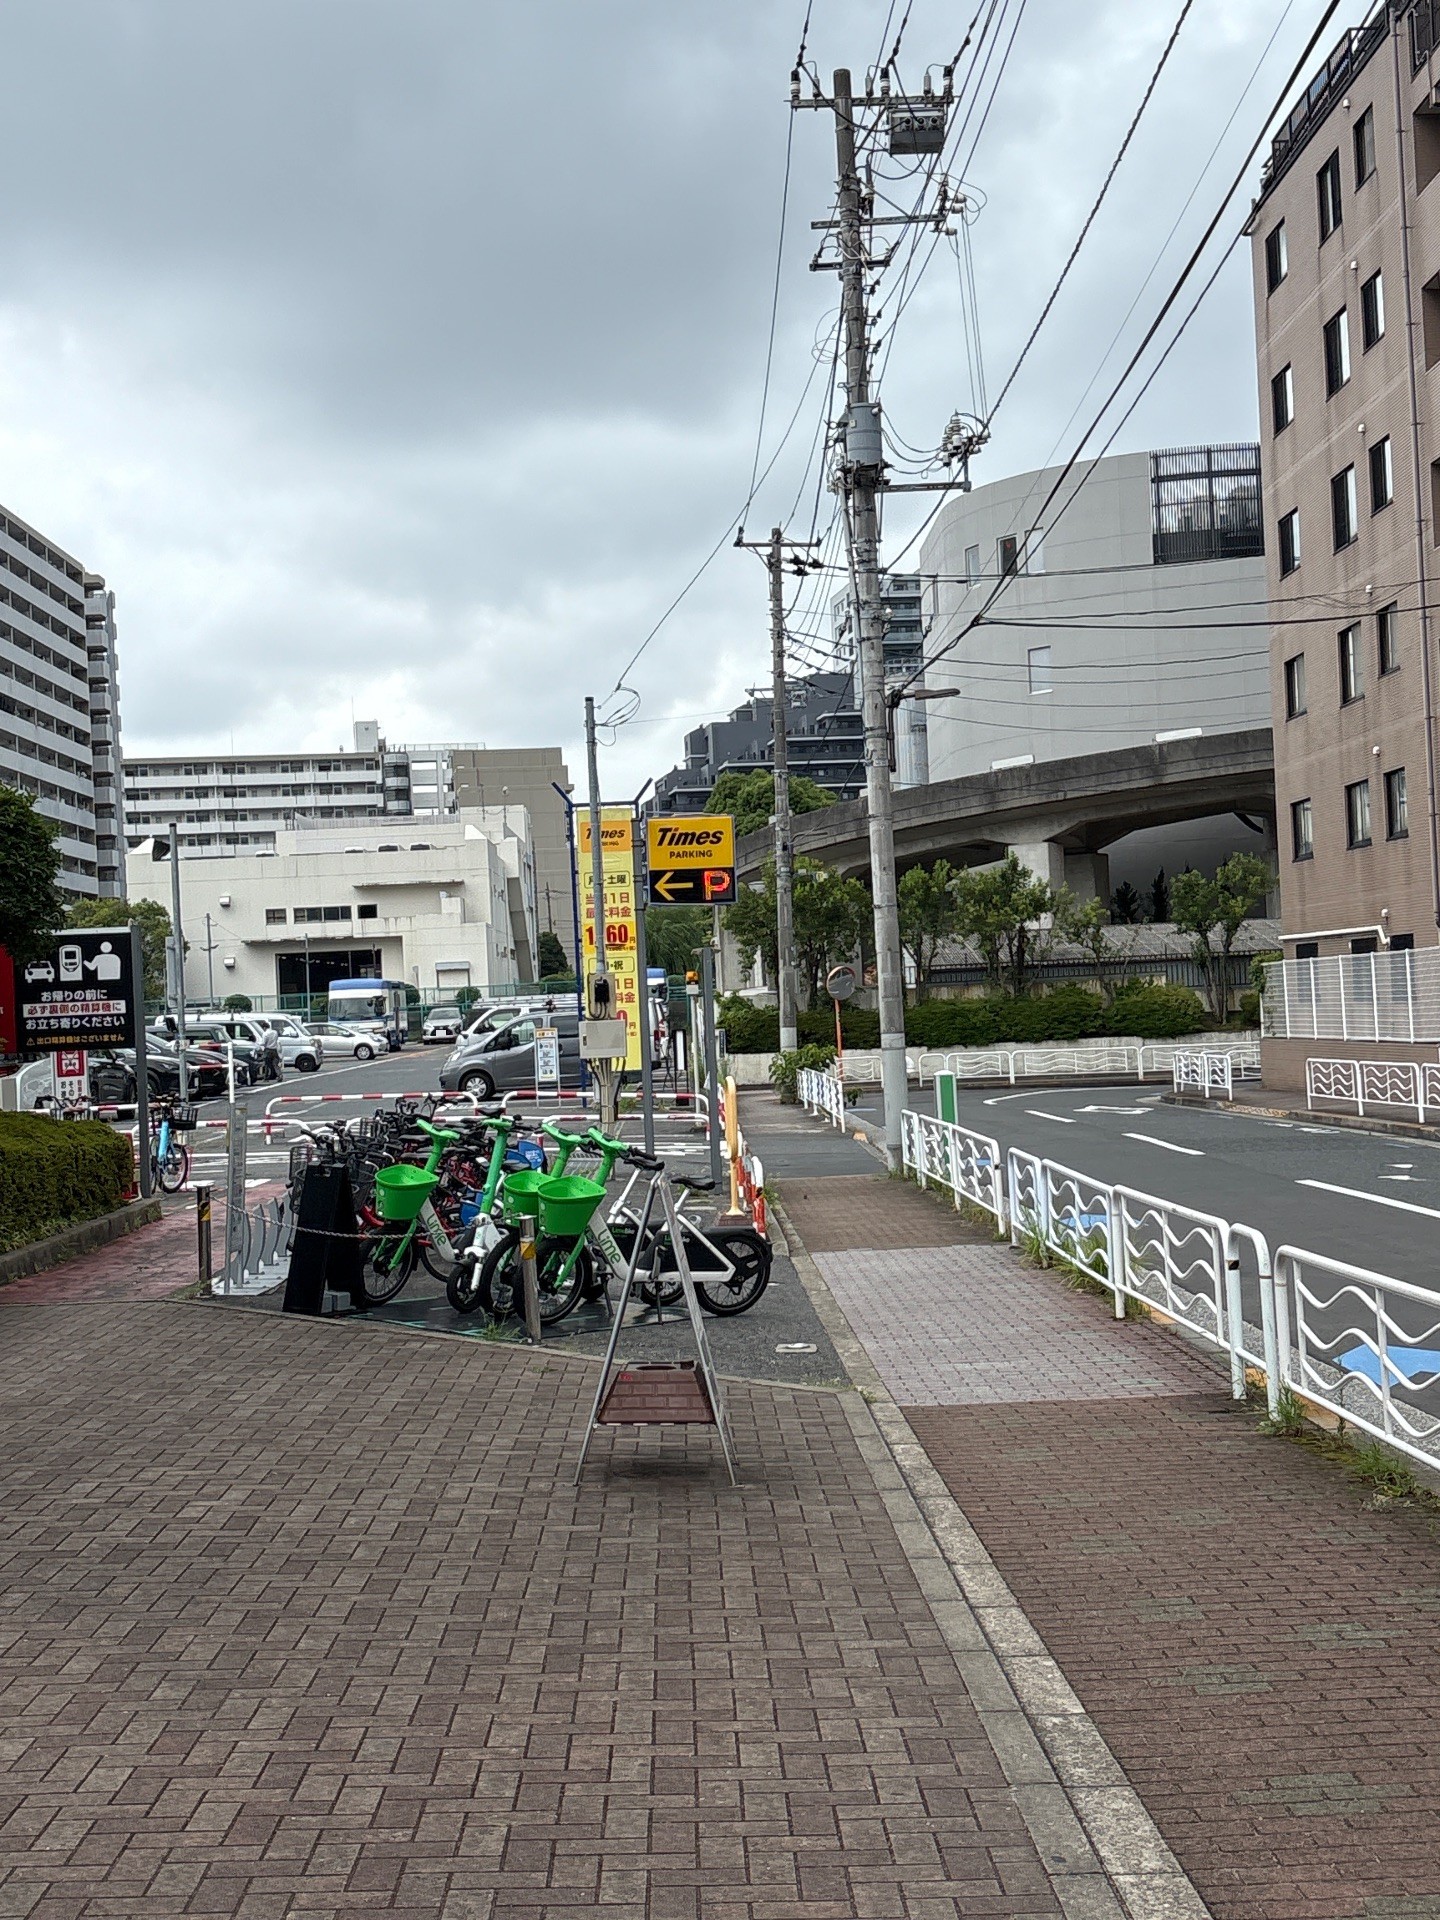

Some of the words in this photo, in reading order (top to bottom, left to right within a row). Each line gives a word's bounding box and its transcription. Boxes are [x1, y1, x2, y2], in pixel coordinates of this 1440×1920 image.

[586, 827, 625, 840] Tmes
[657, 827, 724, 846] Times
[669, 850, 713, 859] PARKING
[704, 870, 730, 900] P
[41, 989, 108, 1002] お帰りの前に
[28, 1002, 122, 1015] 必ず裏側の精算機に
[26, 1016, 125, 1030] お立ち寄りください
[427, 1213, 447, 1246] Lime
[598, 1228, 621, 1264] Lime
